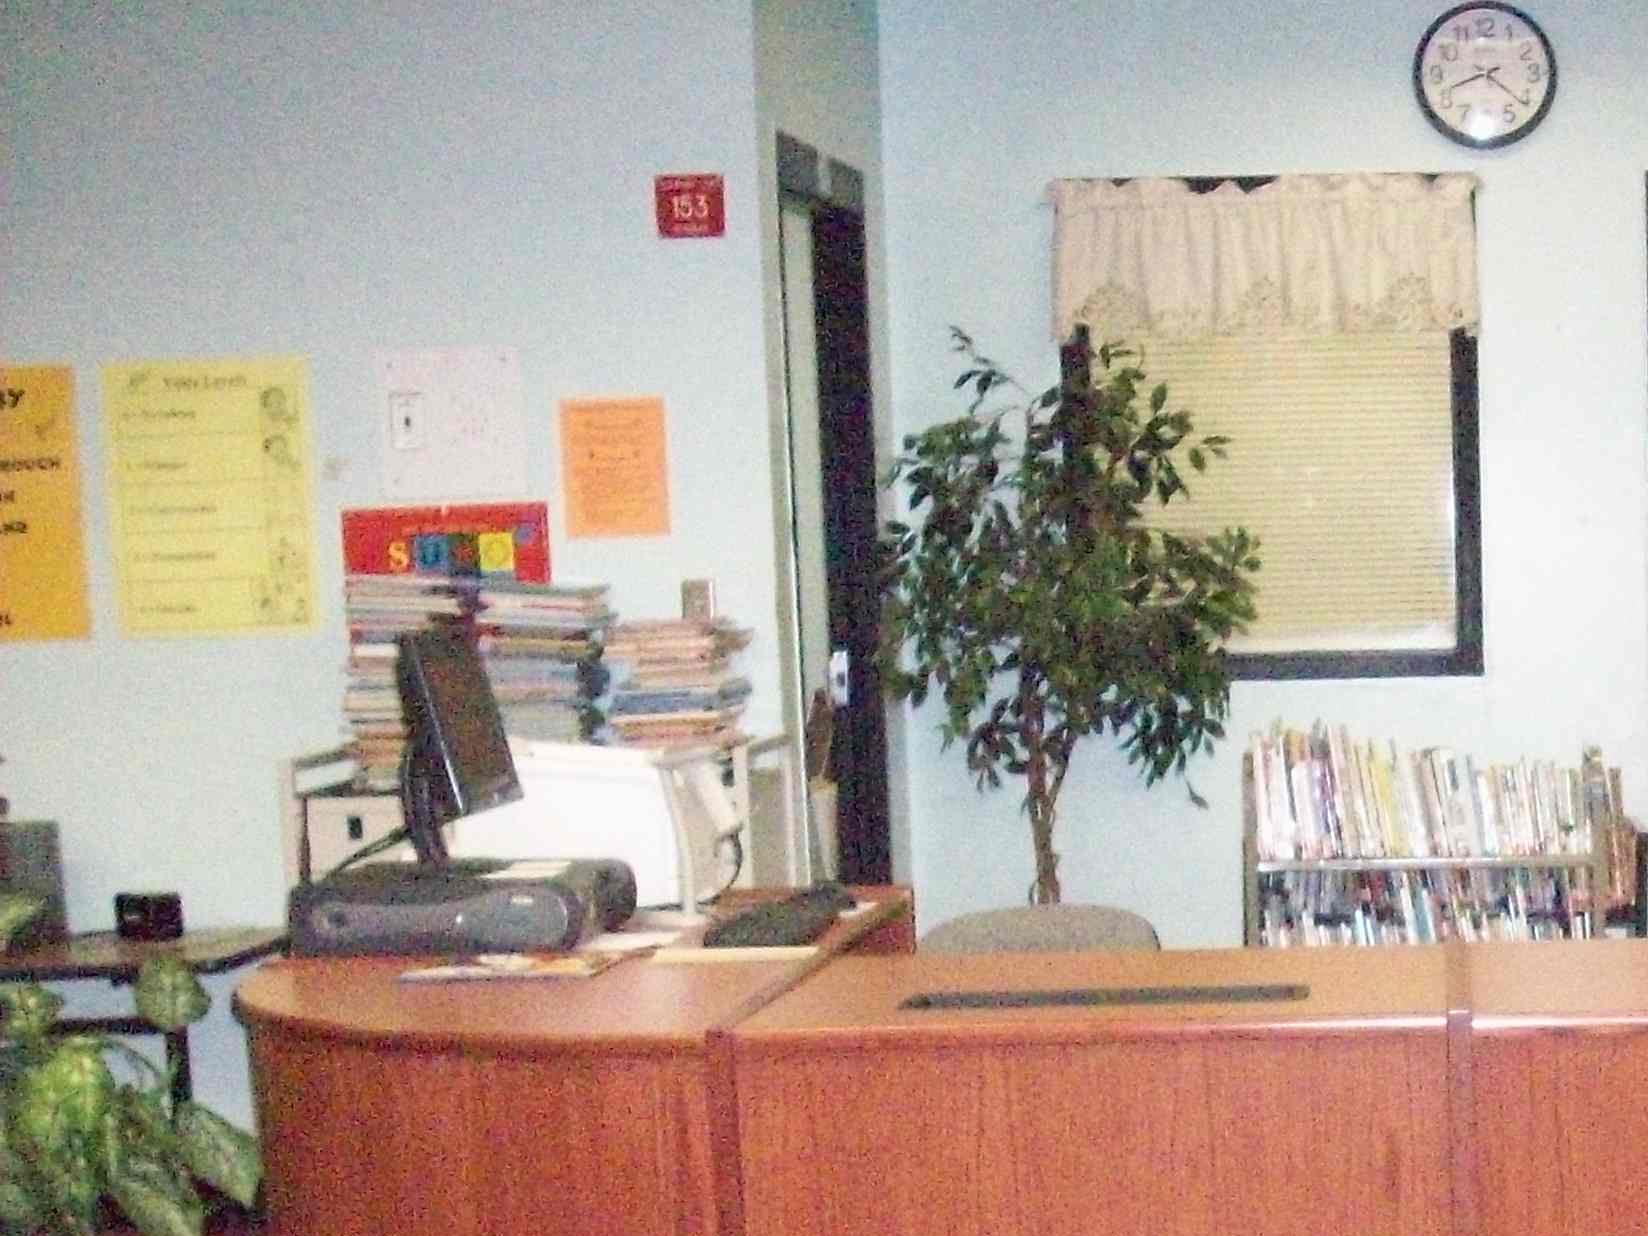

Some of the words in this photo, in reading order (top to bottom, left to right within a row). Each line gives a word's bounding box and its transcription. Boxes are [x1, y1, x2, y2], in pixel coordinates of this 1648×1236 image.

[1454, 25, 1470, 43] 11
[1474, 17, 1495, 38] 12
[1504, 24, 1513, 41] 1
[1439, 43, 1459, 62] 10
[1519, 42, 1533, 62] 2
[1429, 64, 1444, 85] 9
[1527, 63, 1541, 84] 3
[1456, 103, 1472, 123] 7
[1503, 103, 1517, 124] 5
